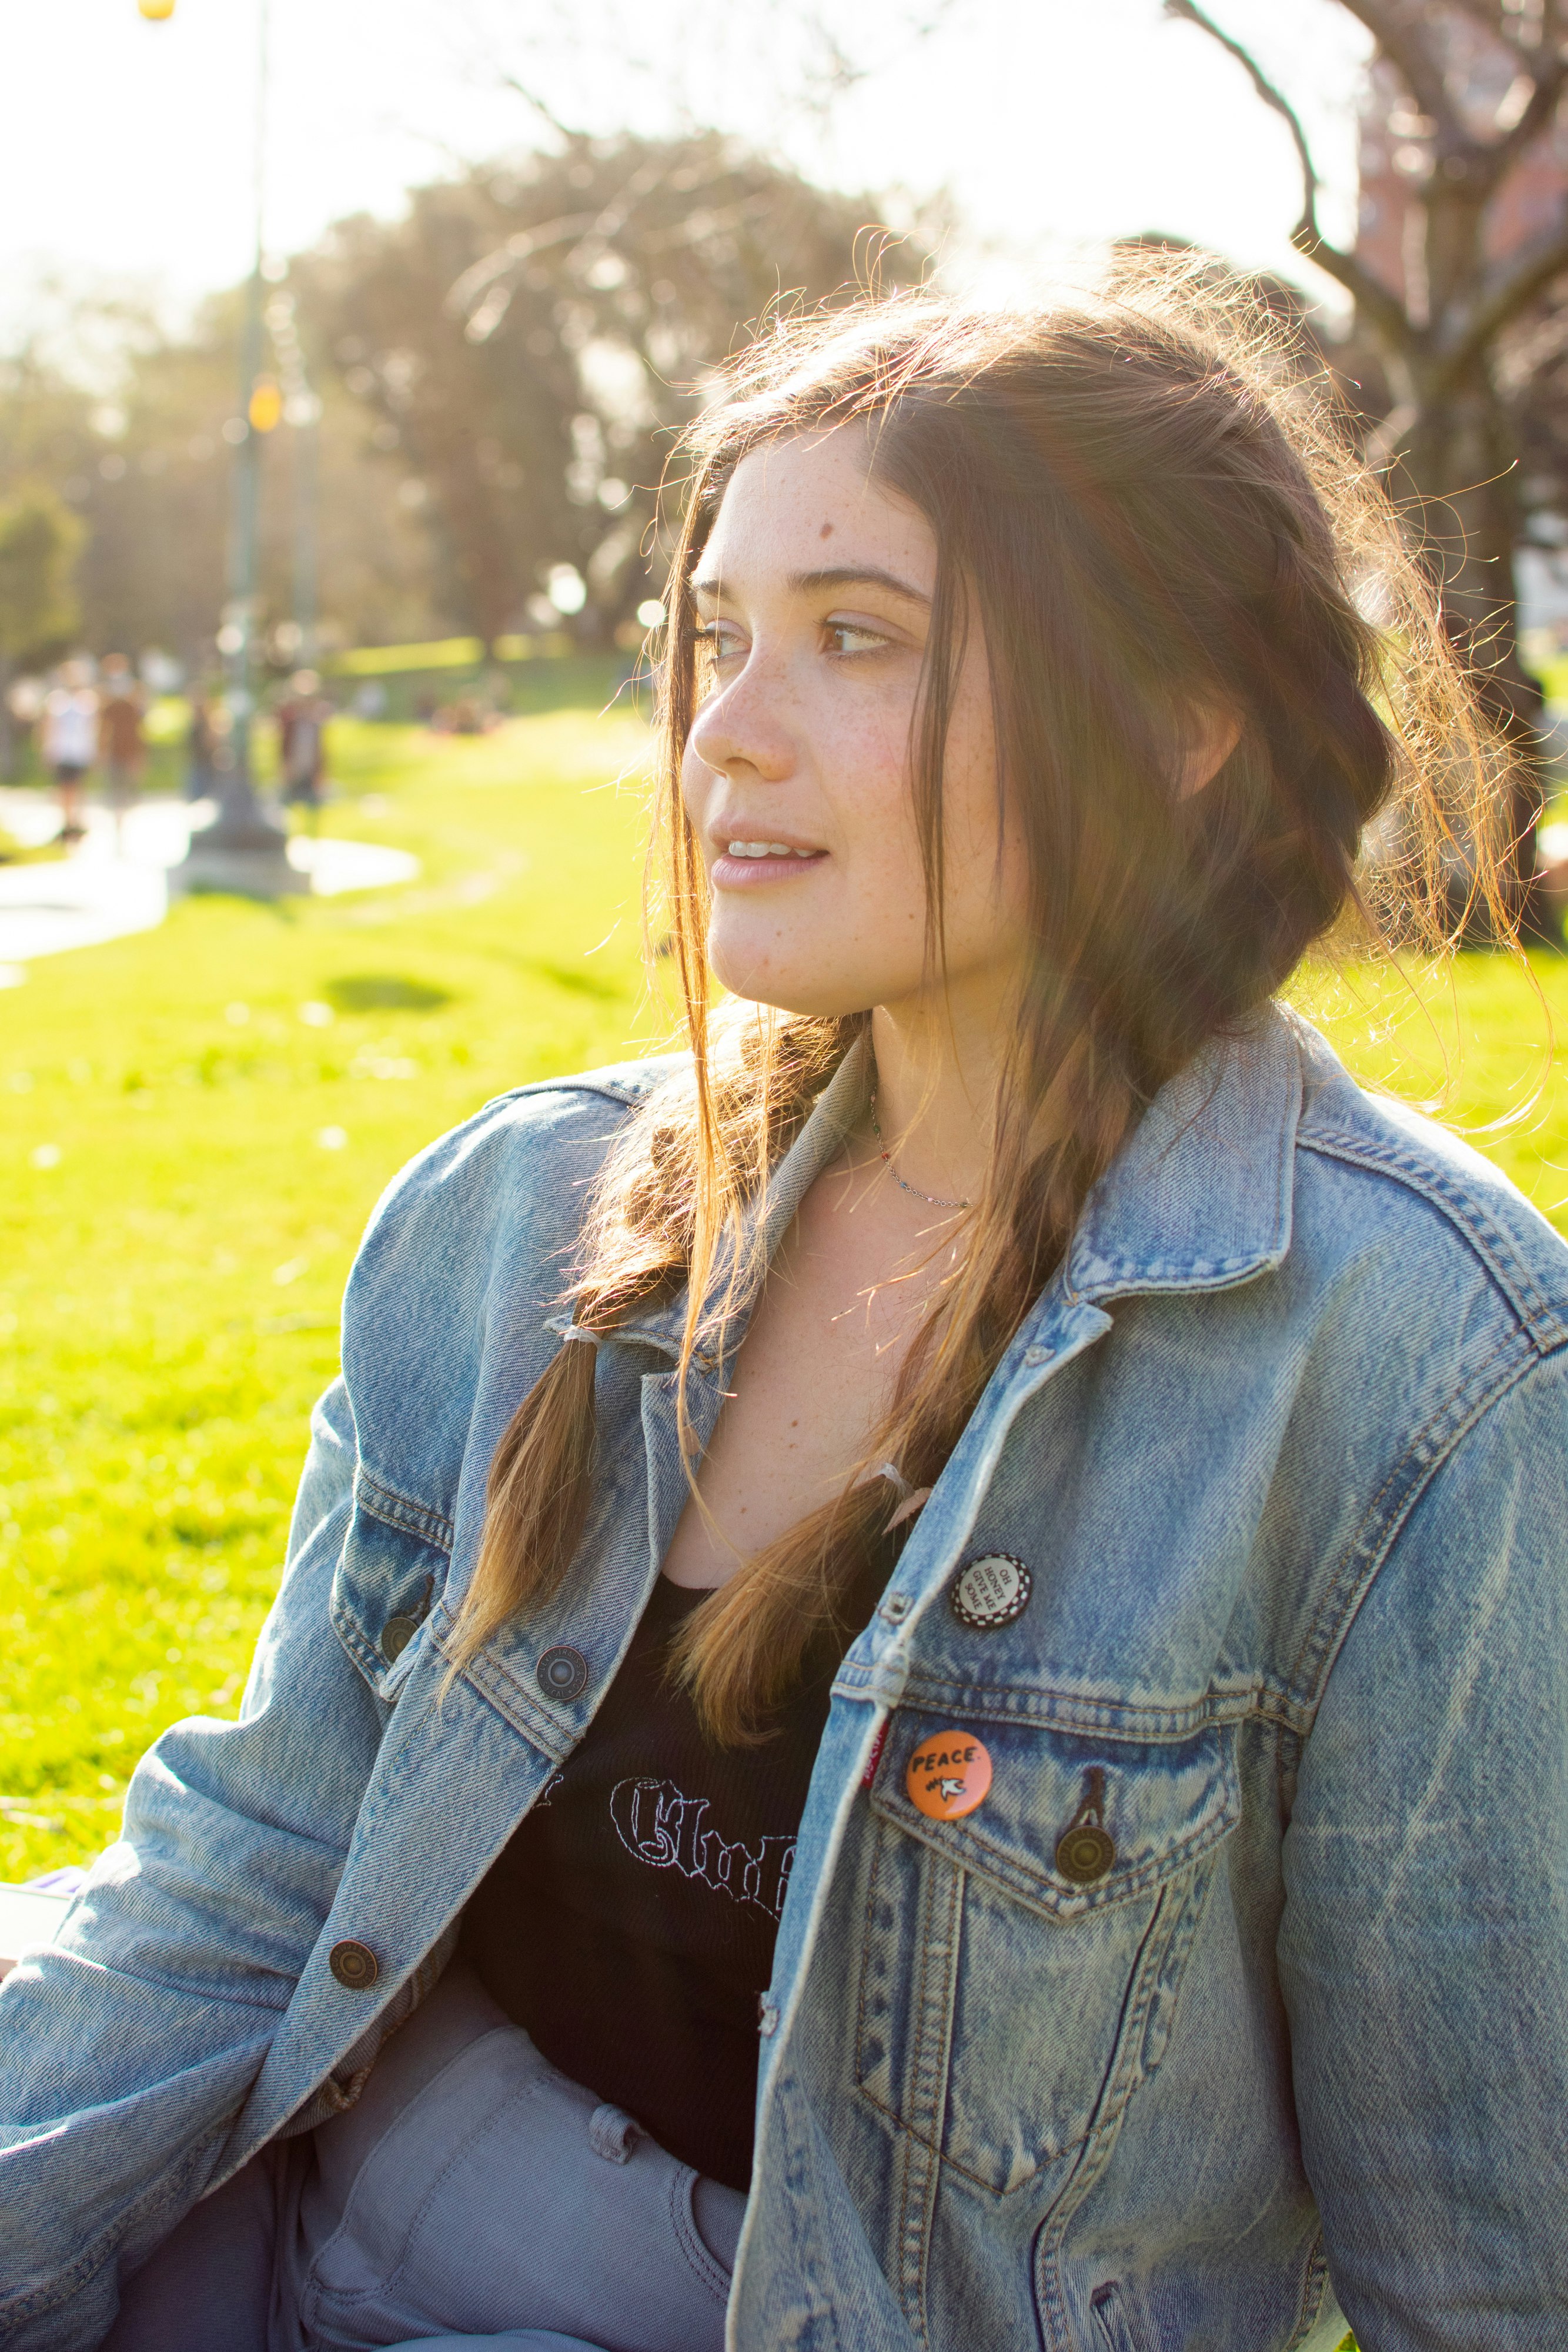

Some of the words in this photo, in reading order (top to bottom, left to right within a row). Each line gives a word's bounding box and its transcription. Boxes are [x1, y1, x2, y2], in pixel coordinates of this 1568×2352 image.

[973, 1570, 988, 1594] GIVE
[983, 1593, 996, 1611] ME
[984, 1566, 1006, 1600] HONEY
[999, 1569, 1012, 1585] OH
[965, 1582, 982, 1610] SOME
[540, 1653, 551, 1671] LEVI
[553, 1648, 583, 1668] STRAUSS
[912, 1746, 978, 1773] PEACE
